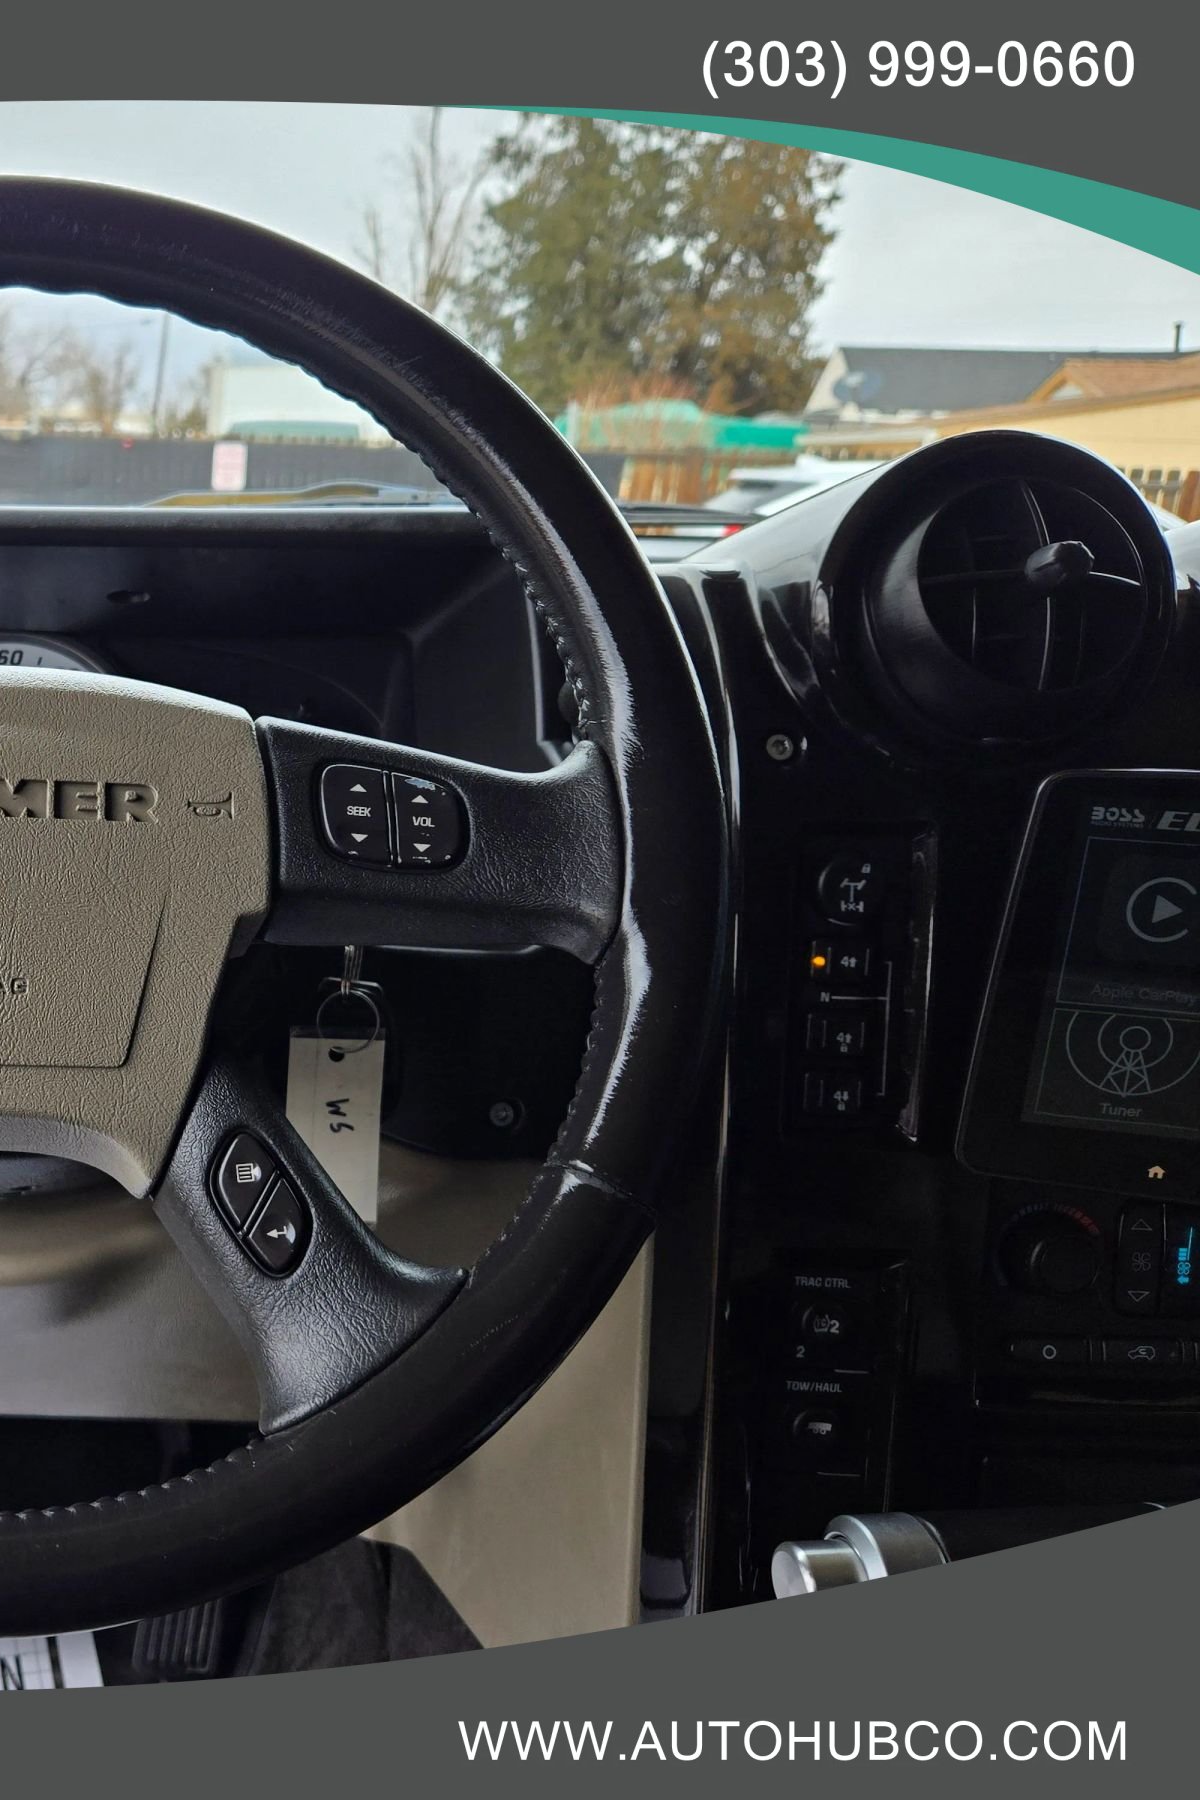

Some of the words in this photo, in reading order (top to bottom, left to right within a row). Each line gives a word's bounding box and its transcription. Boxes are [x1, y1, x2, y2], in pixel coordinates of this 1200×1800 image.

[346, 805, 371, 817] SEEK
[1090, 806, 1145, 823] BOSS
[412, 816, 435, 827] VOL
[820, 992, 831, 1003] N
[1090, 984, 1134, 1000] Apple
[1099, 1103, 1143, 1118] Tuner
[794, 1276, 825, 1288] TRAC
[825, 1277, 851, 1289] CTRL
[795, 1345, 806, 1359] 2
[785, 1380, 843, 1393] TOW/HAUL
